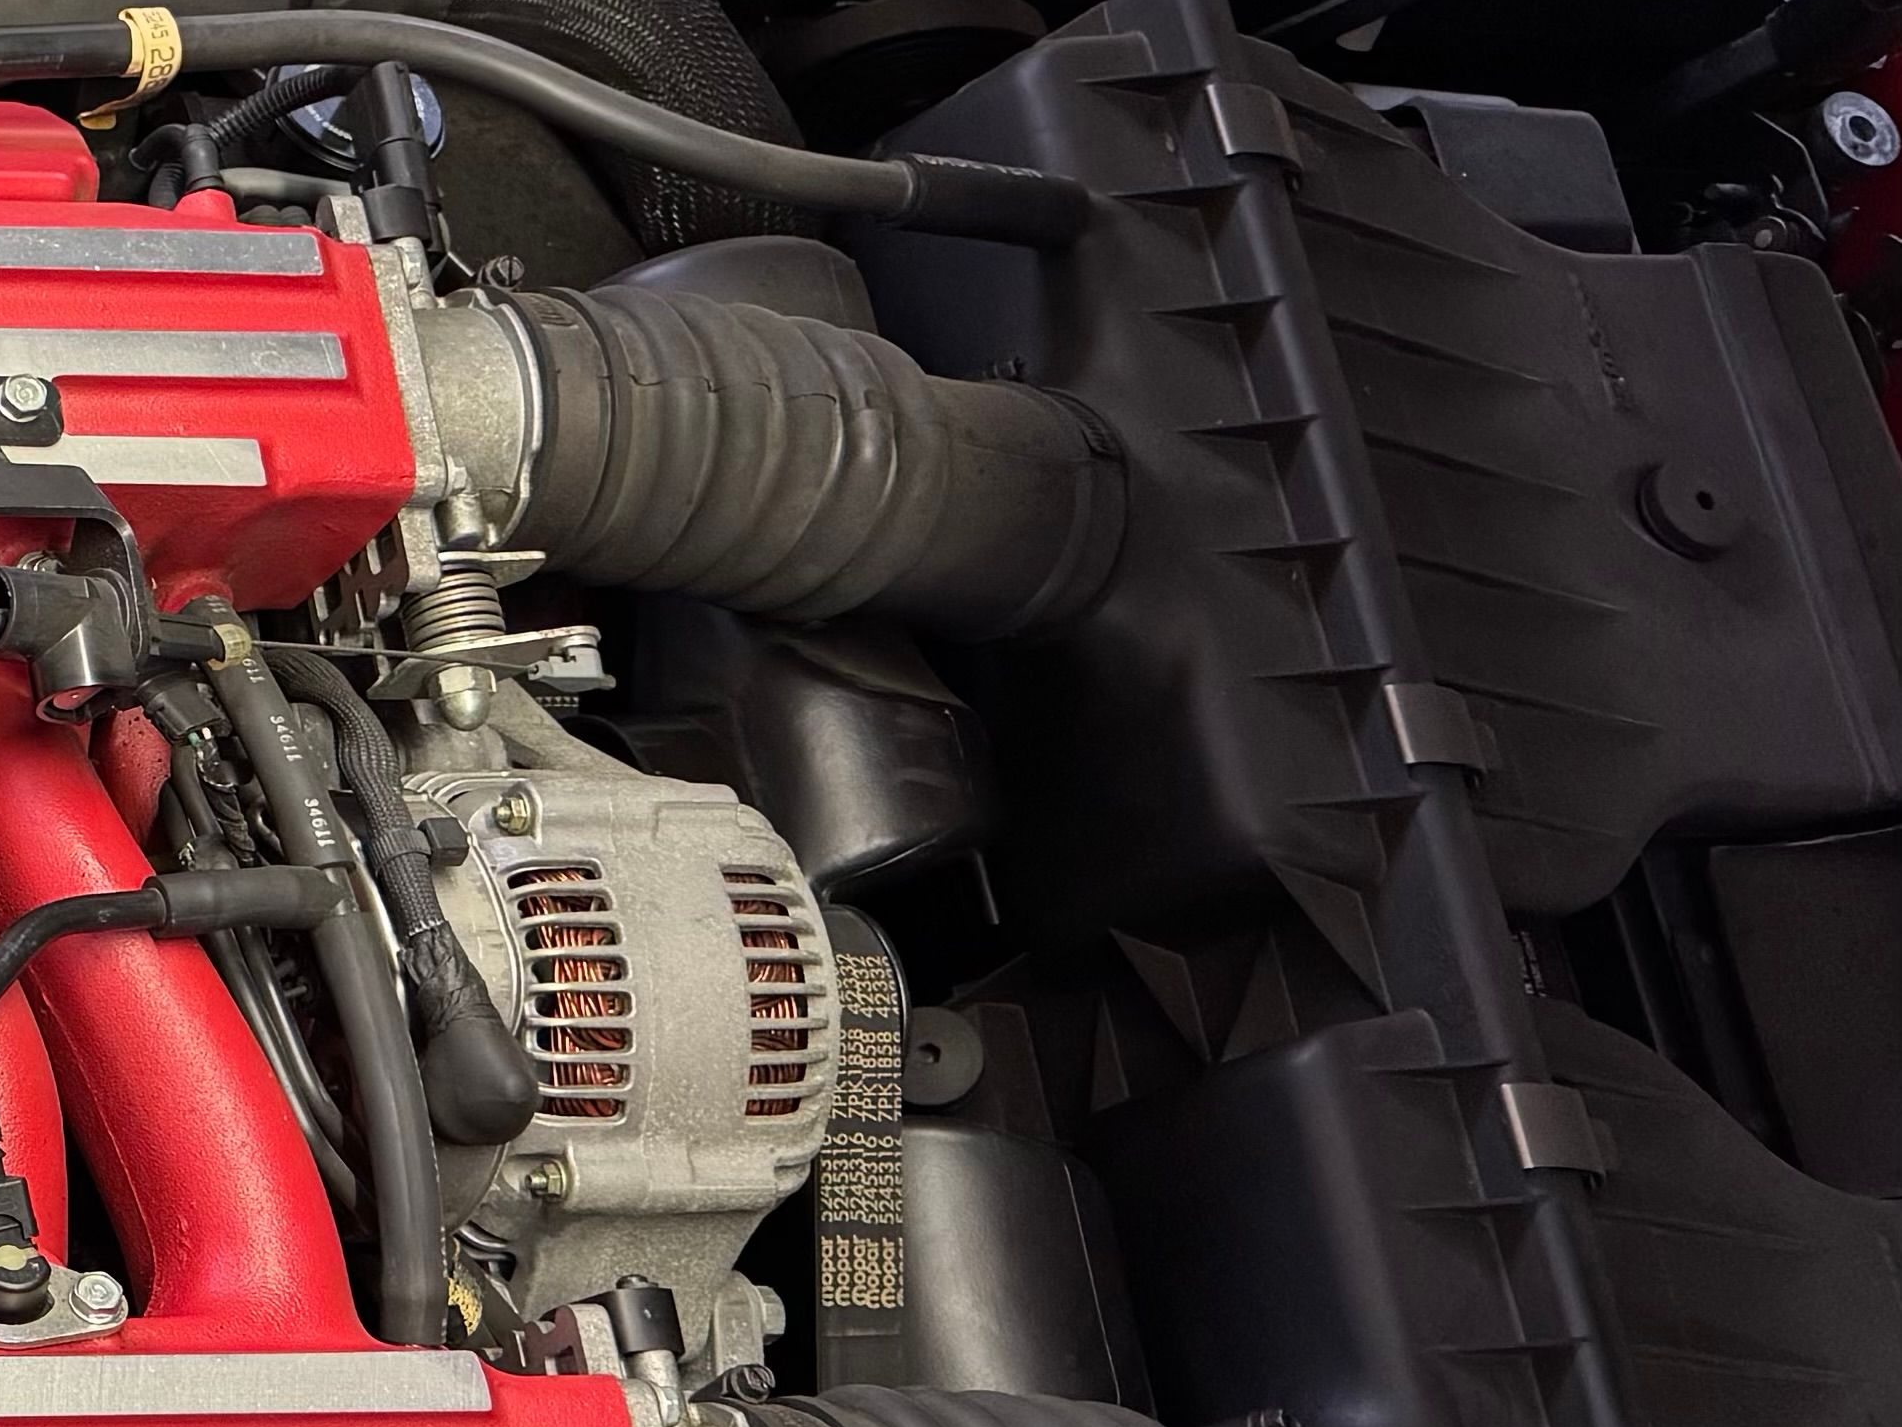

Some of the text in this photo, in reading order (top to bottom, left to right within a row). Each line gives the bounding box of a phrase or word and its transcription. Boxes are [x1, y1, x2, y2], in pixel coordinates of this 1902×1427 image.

[865, 955, 891, 1019] 42332
[847, 1028, 864, 1120] 7PK1858
[861, 1031, 878, 1122] 7PK1858
[877, 1030, 894, 1122] 7PK1858
[833, 1132, 849, 1223] 5245316
[849, 1132, 865, 1223] 5245316
[863, 1135, 879, 1224] 5245316
[878, 1135, 895, 1225] 5245316
